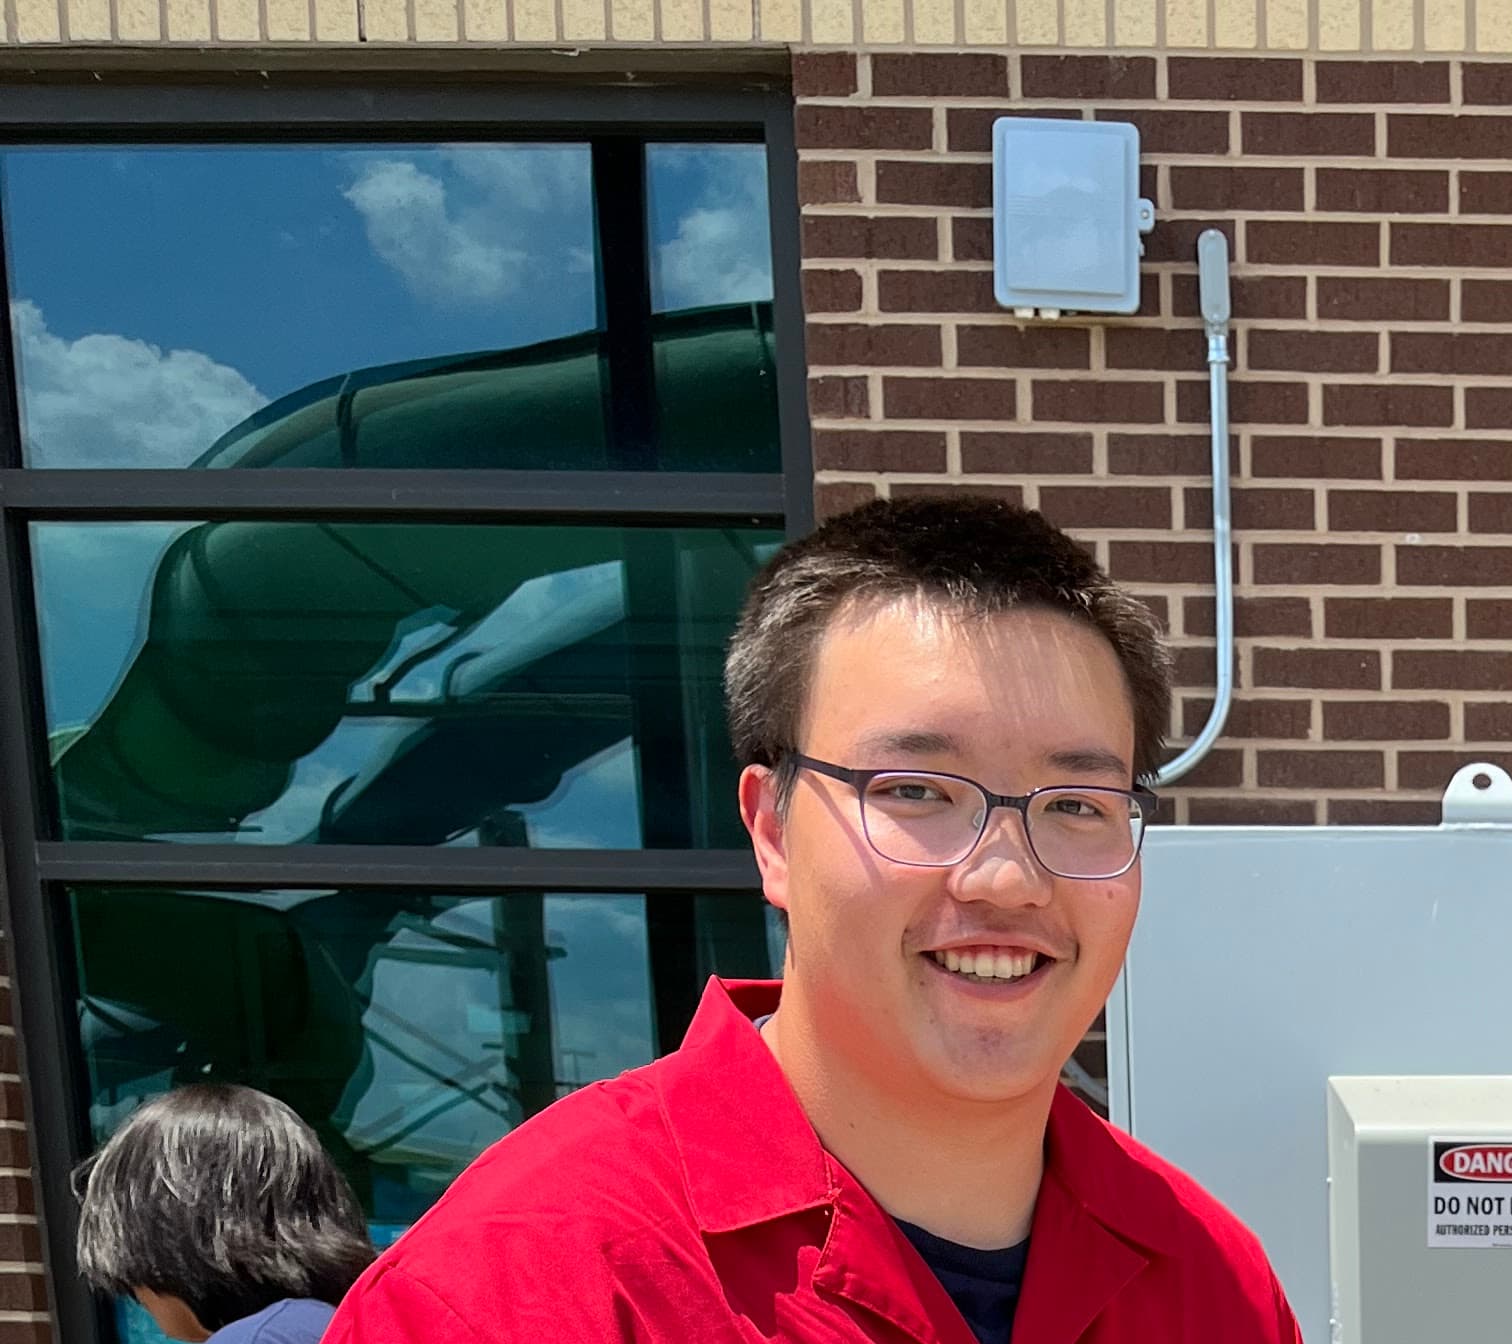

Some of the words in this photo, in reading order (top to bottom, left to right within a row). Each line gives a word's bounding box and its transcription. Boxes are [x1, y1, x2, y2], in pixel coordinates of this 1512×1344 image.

[1434, 1196, 1460, 1215] DO
[1467, 1197, 1505, 1215] NOT
[1435, 1224, 1490, 1236] AUTHORIZED
